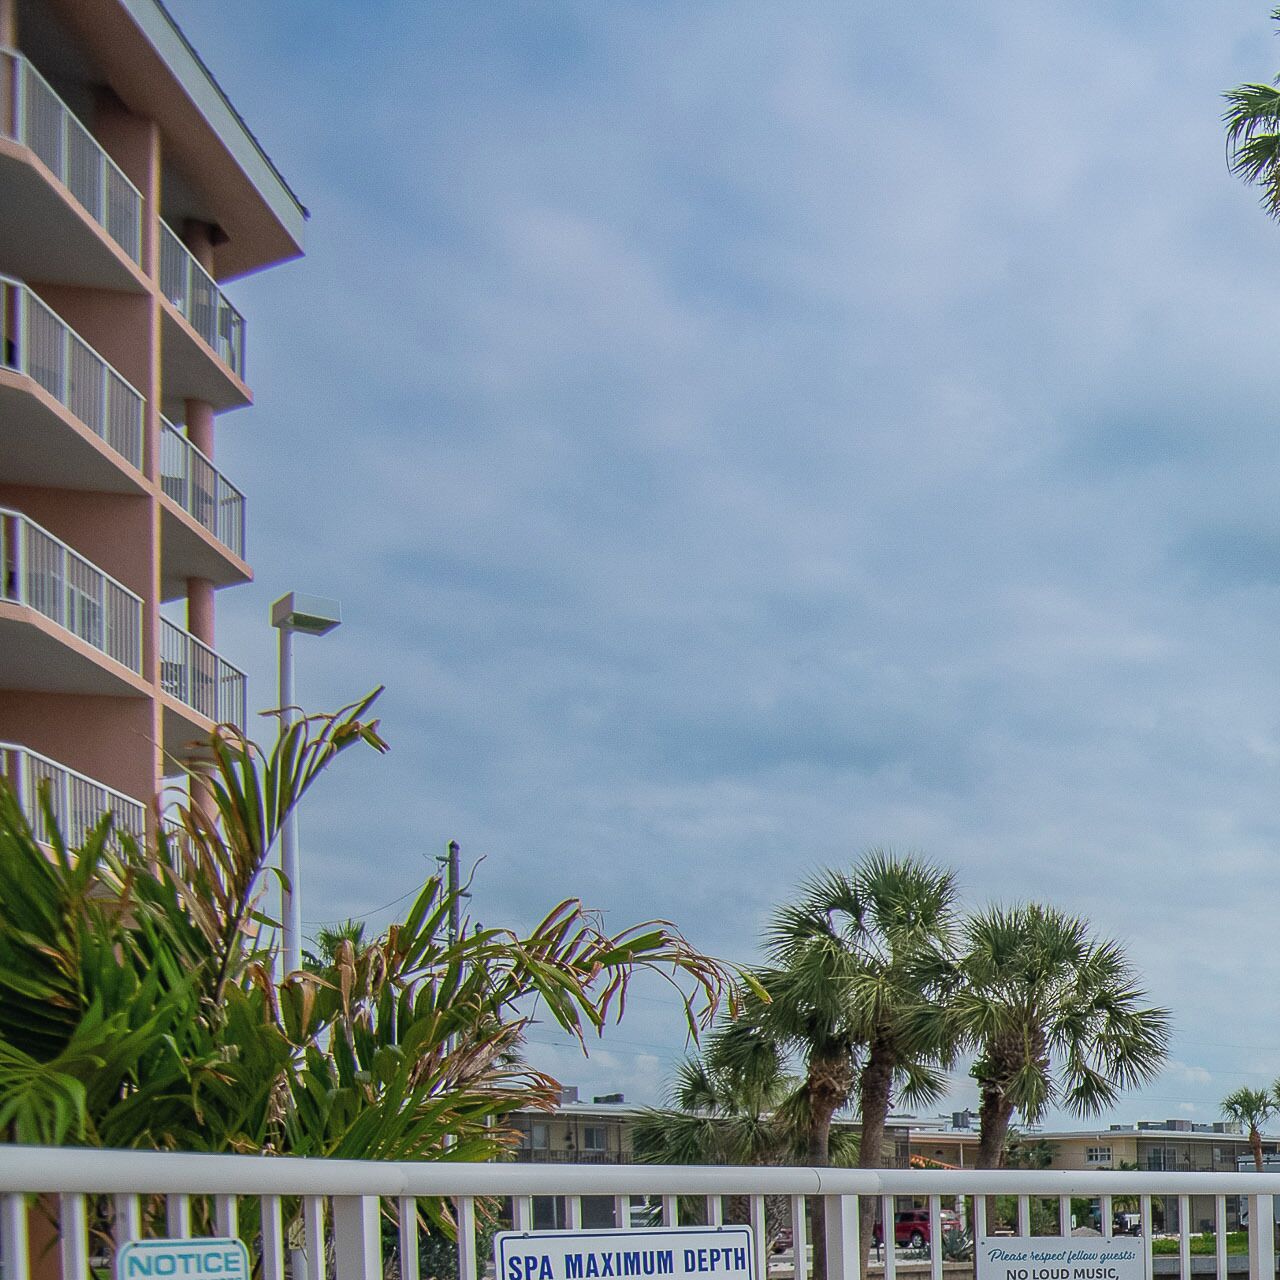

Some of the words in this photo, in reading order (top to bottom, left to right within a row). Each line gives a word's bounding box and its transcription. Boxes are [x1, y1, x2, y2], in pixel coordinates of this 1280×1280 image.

[128, 1252, 240, 1277] NOTICE
[565, 1249, 673, 1279] MAXIMUM
[684, 1247, 746, 1274] DEPTH
[988, 1249, 1027, 1262] Please
[1030, 1251, 1065, 1263] respect
[1067, 1250, 1097, 1264] fellow
[1100, 1251, 1135, 1264] guests:
[1007, 1270, 1028, 1280] NO
[1033, 1269, 1069, 1280] LOUD
[1074, 1268, 1119, 1280] MUSIC,
